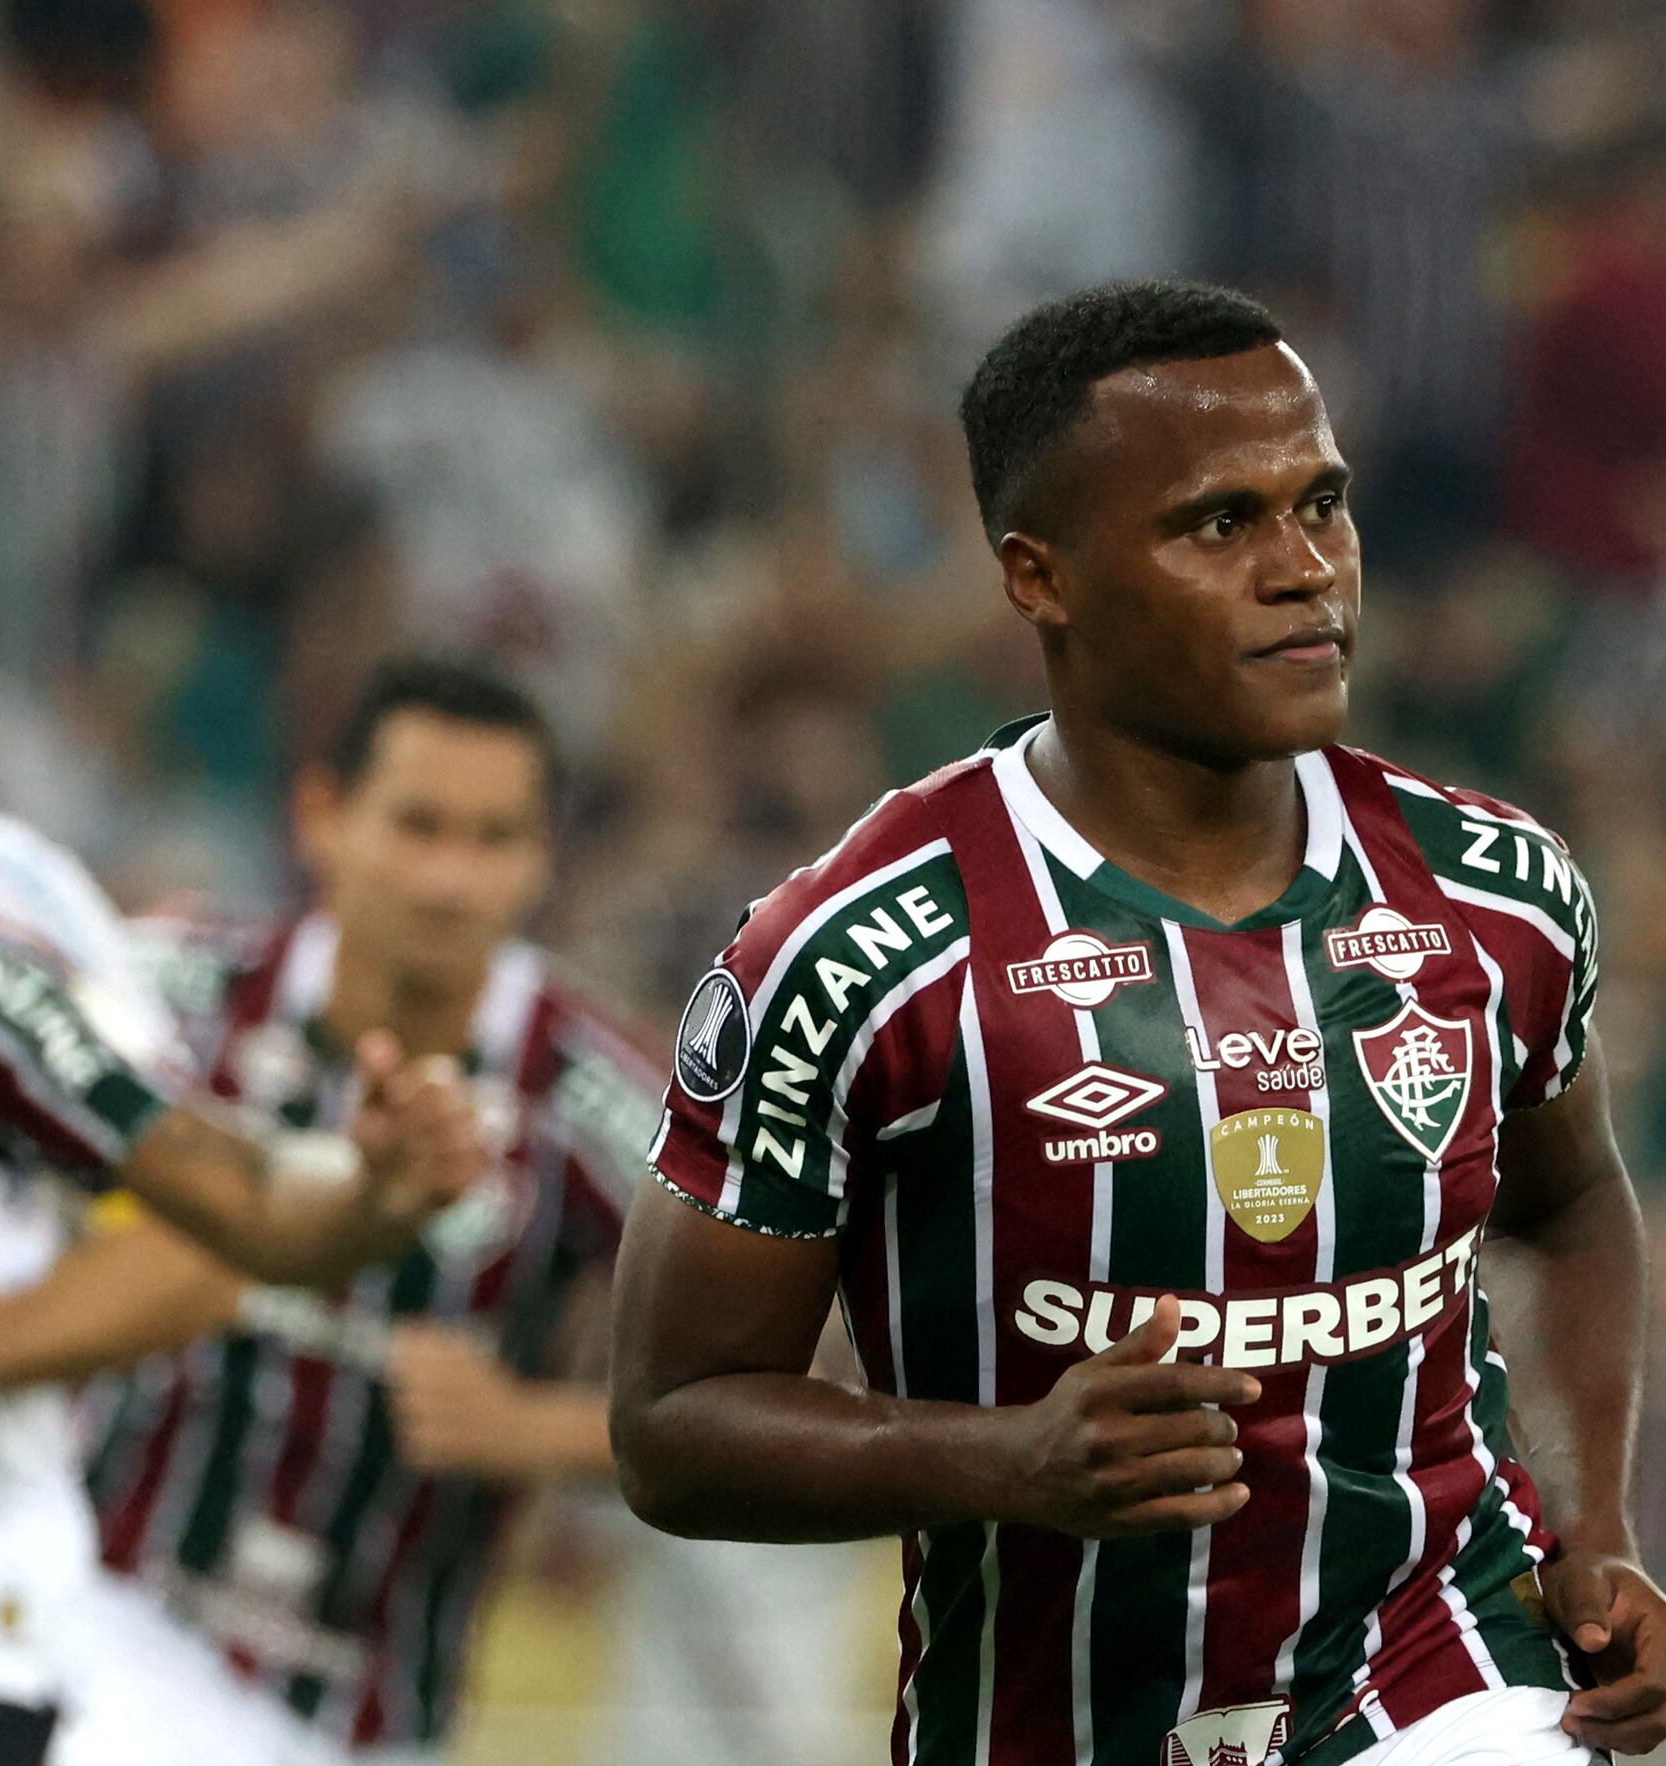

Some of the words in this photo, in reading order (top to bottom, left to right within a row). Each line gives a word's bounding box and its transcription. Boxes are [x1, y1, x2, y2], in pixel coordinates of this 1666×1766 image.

[1336, 930, 1443, 959] FRESCATTO
[1016, 958, 1140, 987] FRESCATTO
[750, 884, 955, 1180] ZINZANE
[1187, 1027, 1322, 1070] Leve
[1256, 1064, 1324, 1091] saúde
[1220, 1113, 1315, 1136] CAMPEÓN
[1045, 1130, 1157, 1163] umbro
[1230, 1202, 1241, 1210] LA
[1232, 1185, 1307, 1200] LIBERTADORES
[1255, 1213, 1285, 1224] 2023
[1014, 1224, 1479, 1369] SUPERBET
